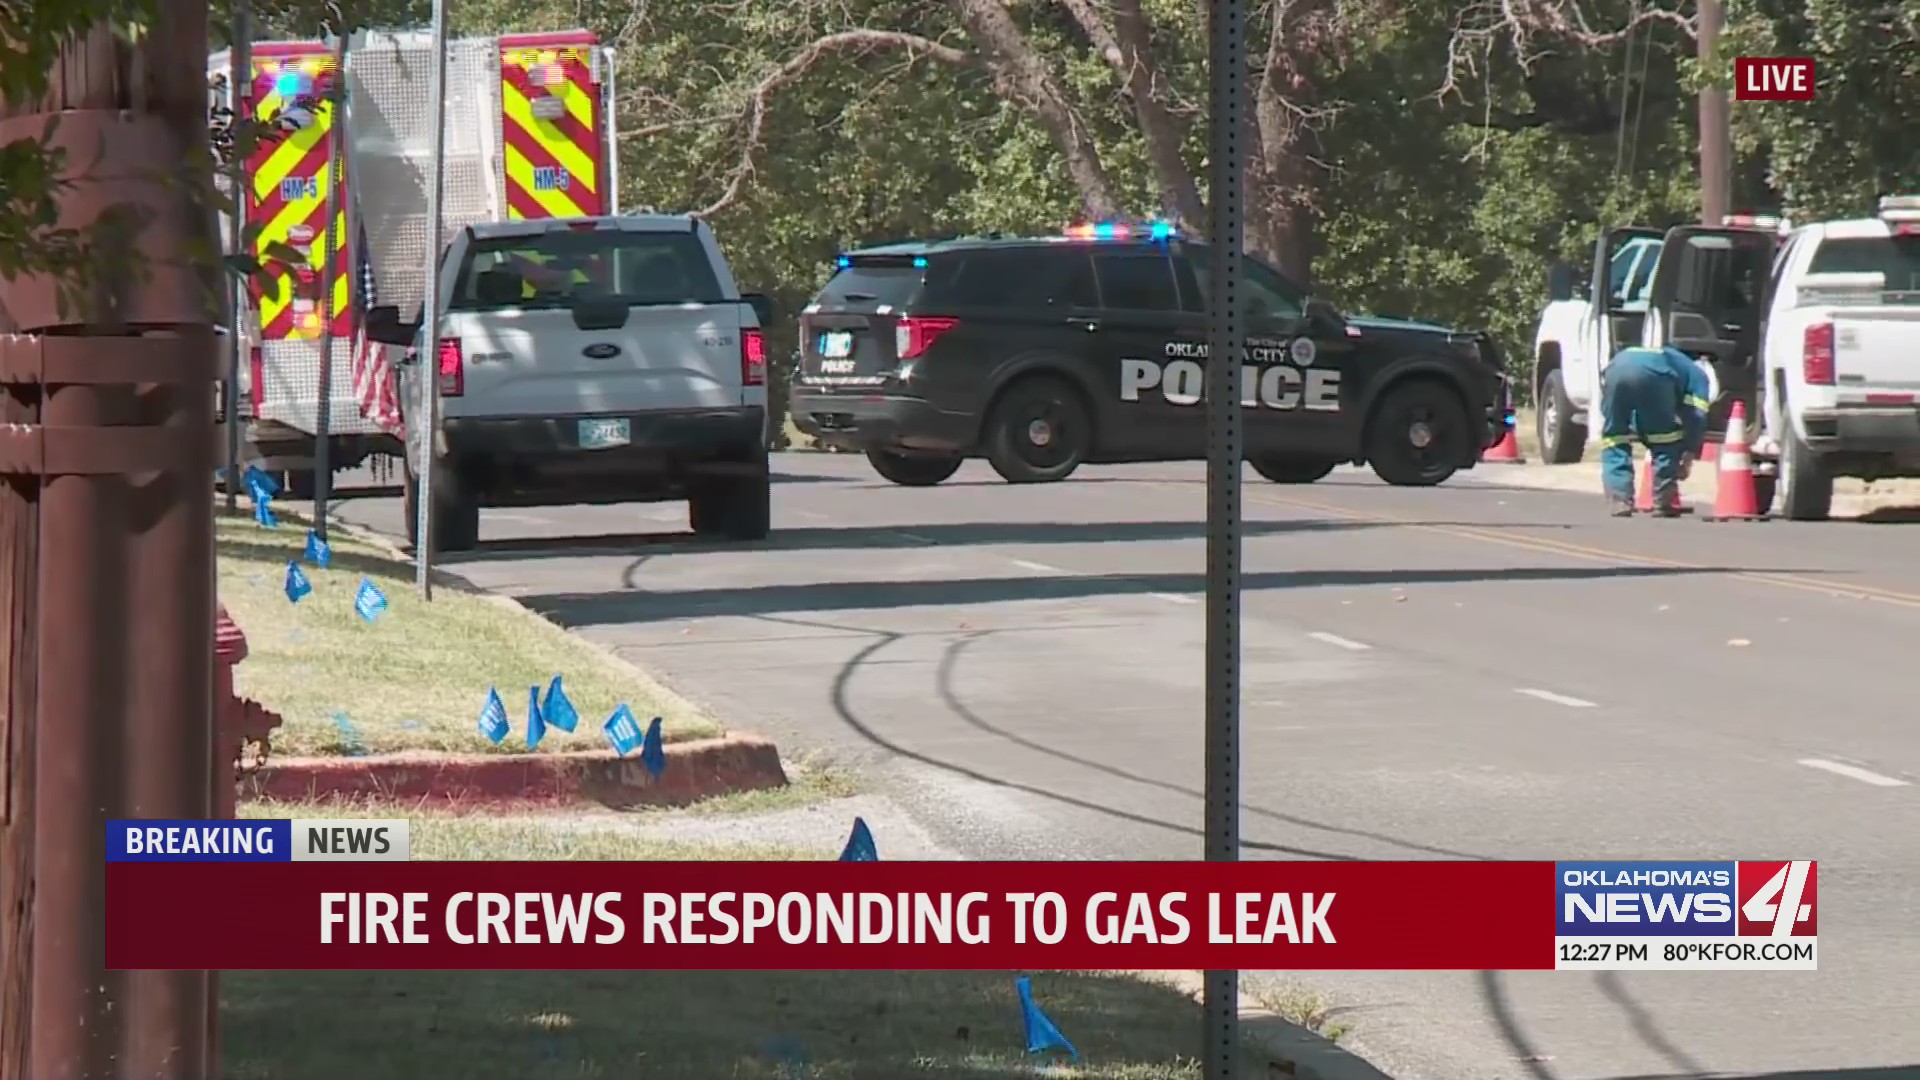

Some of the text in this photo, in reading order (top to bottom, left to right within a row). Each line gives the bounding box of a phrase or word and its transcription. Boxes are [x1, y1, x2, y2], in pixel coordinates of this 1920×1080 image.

[281, 176, 318, 199] HM-5
[533, 168, 568, 190] HM-5
[1252, 347, 1287, 362] CITY
[1120, 358, 1342, 411] POICE
